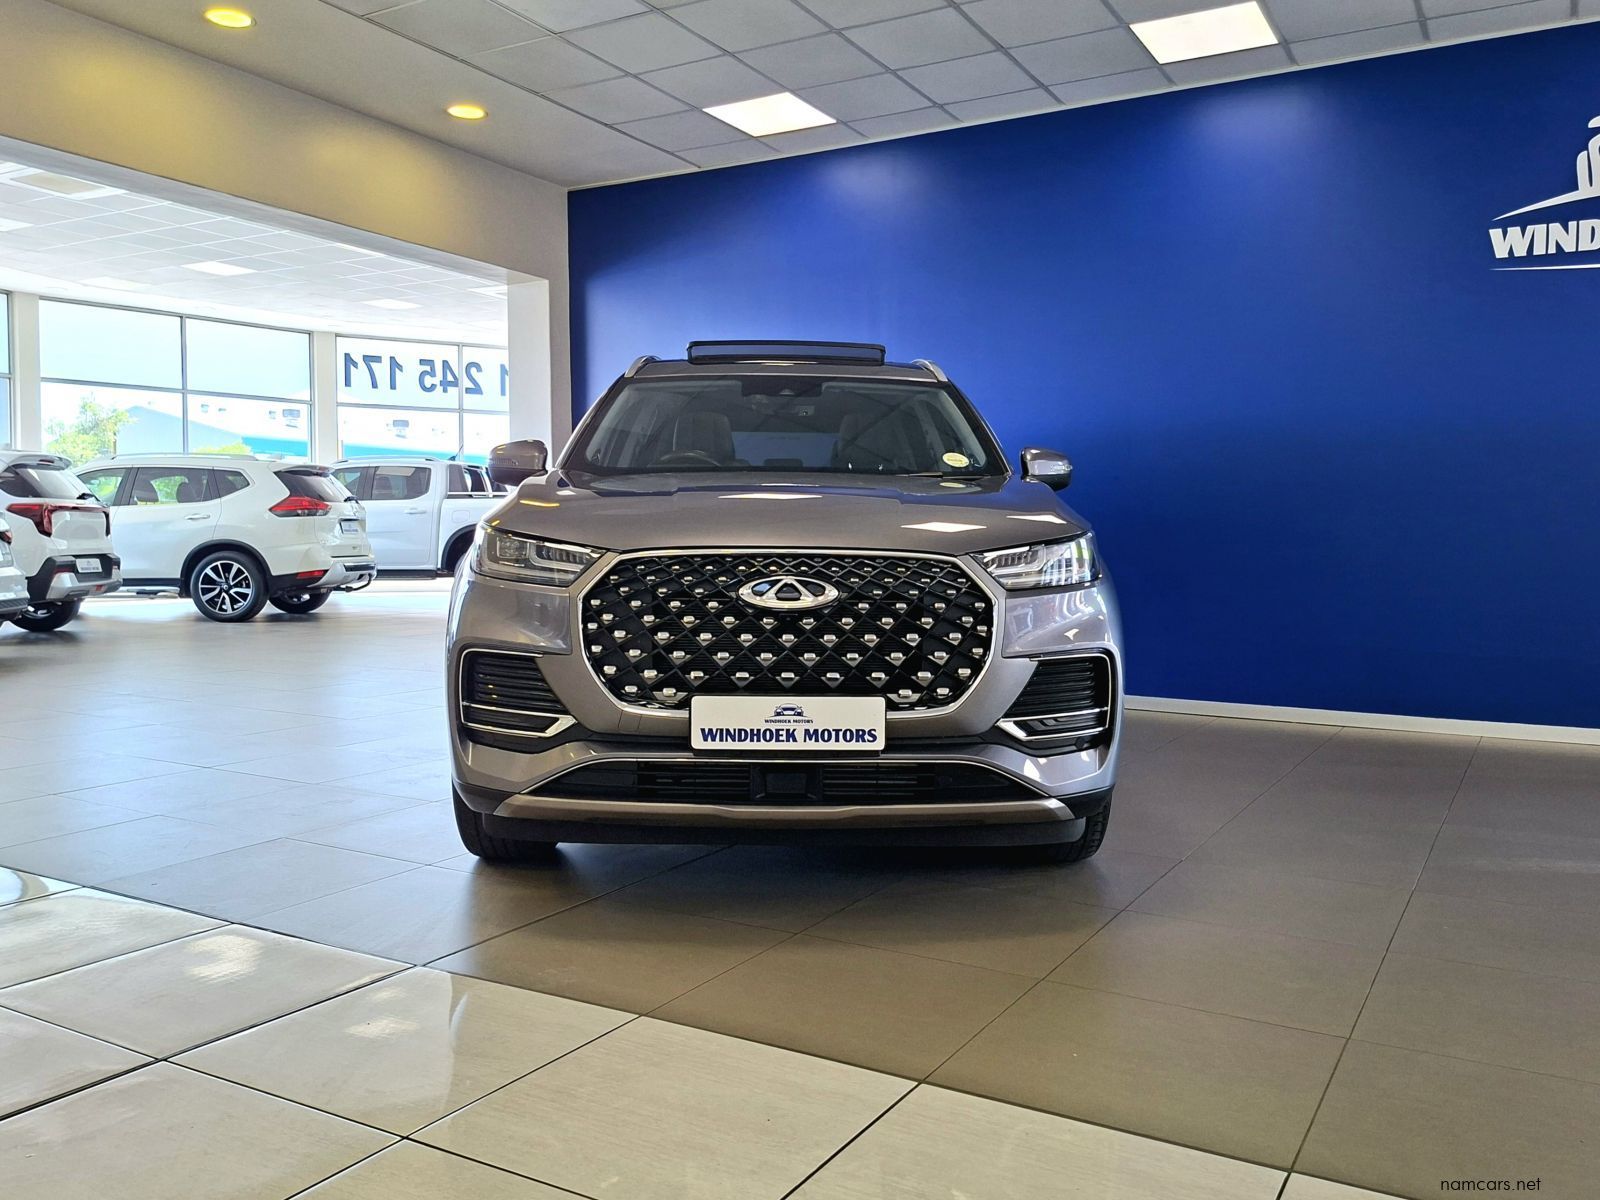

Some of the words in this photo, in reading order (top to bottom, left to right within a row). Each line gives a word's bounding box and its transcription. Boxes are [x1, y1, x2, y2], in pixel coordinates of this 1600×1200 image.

[1488, 218, 1600, 259] WIND
[700, 727, 798, 743] WINDHOEK
[803, 728, 878, 743] MOTORS
